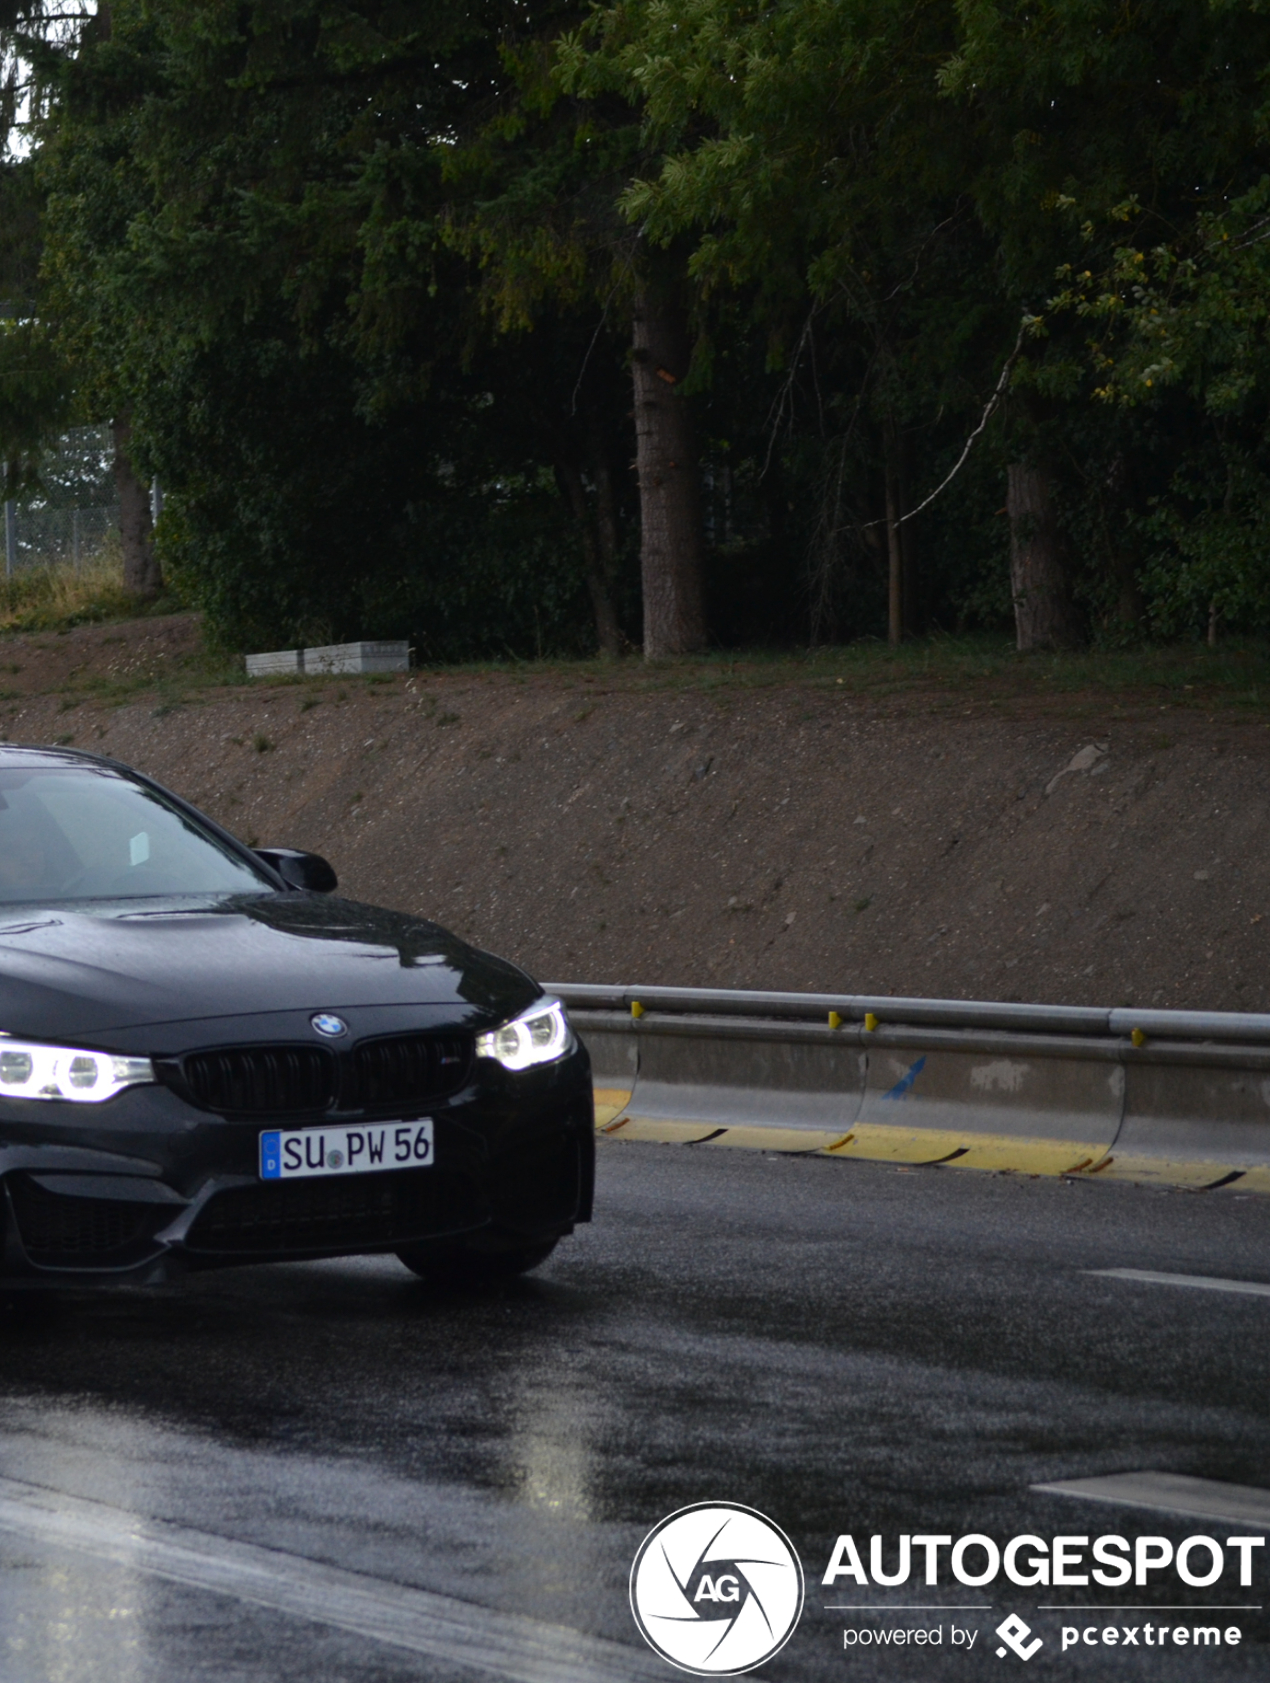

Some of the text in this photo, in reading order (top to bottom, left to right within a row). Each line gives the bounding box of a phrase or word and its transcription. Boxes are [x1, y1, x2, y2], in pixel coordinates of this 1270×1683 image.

[283, 1126, 430, 1171] SU PW 56
[267, 1159, 276, 1171] D
